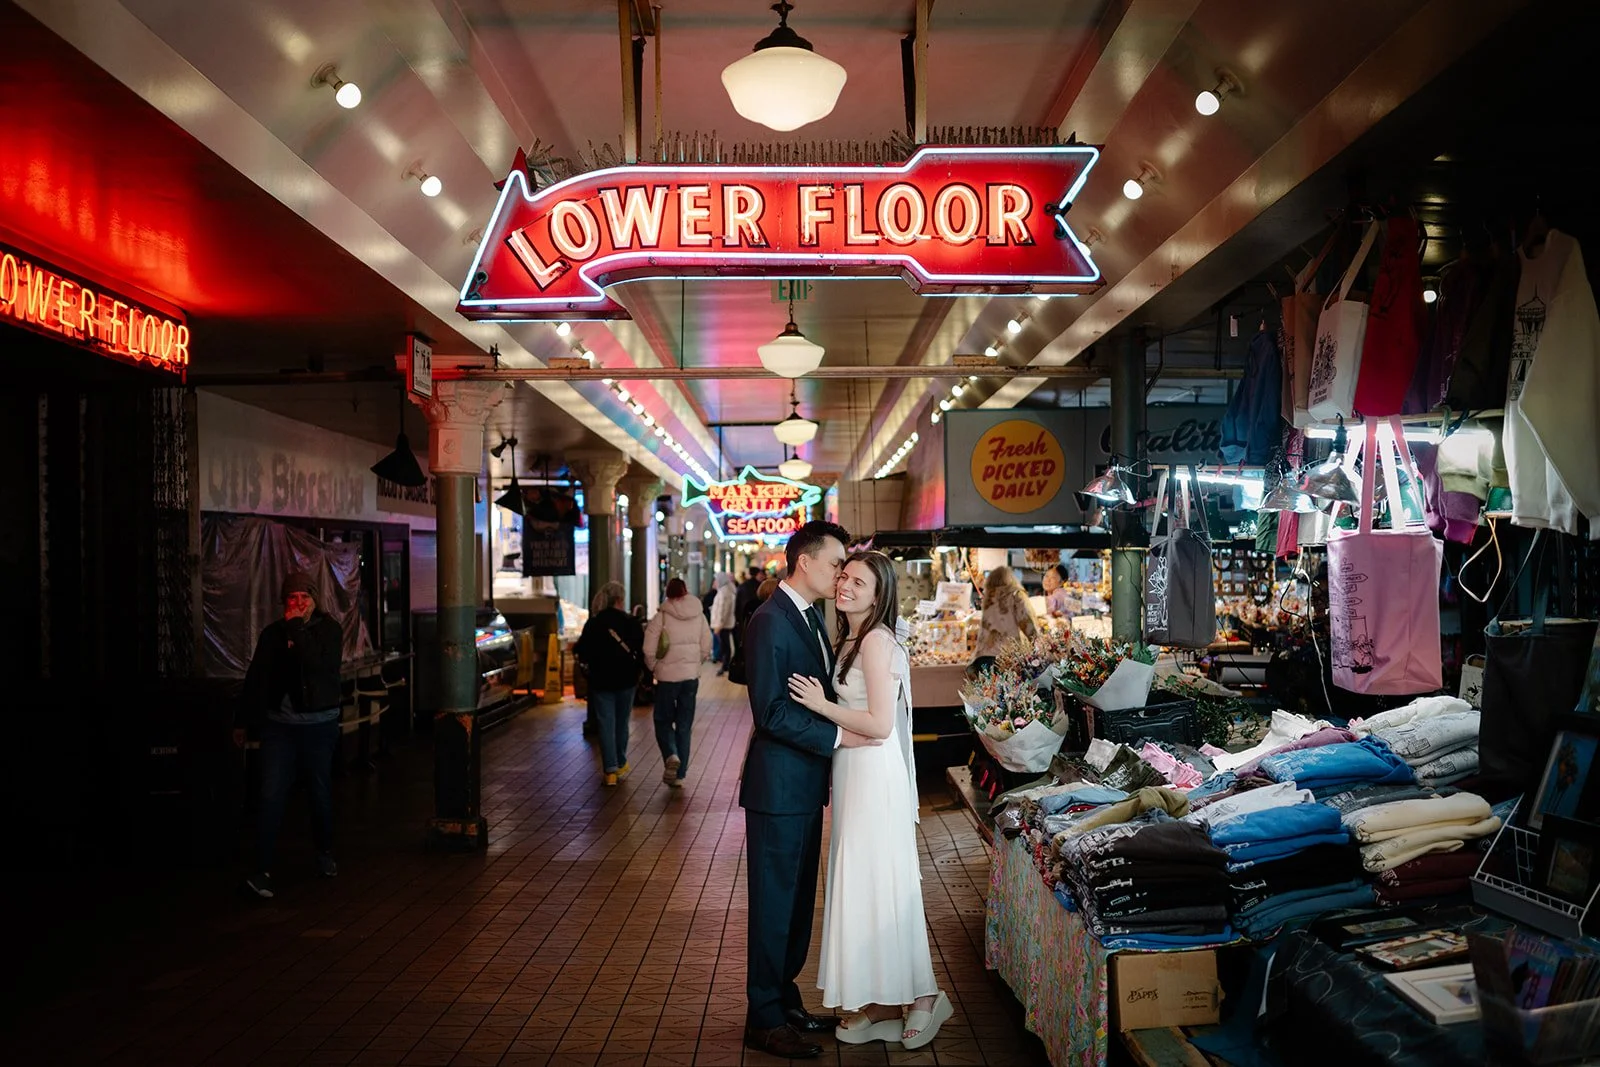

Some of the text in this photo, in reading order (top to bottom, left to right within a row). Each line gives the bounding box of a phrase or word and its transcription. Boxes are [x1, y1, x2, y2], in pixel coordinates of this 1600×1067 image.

[505, 182, 1035, 291] LOWER FLOOR
[106, 298, 190, 367] FLOOR
[988, 430, 1048, 461] Fresh
[982, 458, 1056, 482] PICKED
[709, 484, 799, 499] MARKET
[991, 479, 1049, 500] DAILY
[721, 498, 786, 512] GRILL
[727, 518, 796, 534] SEAFOOD
